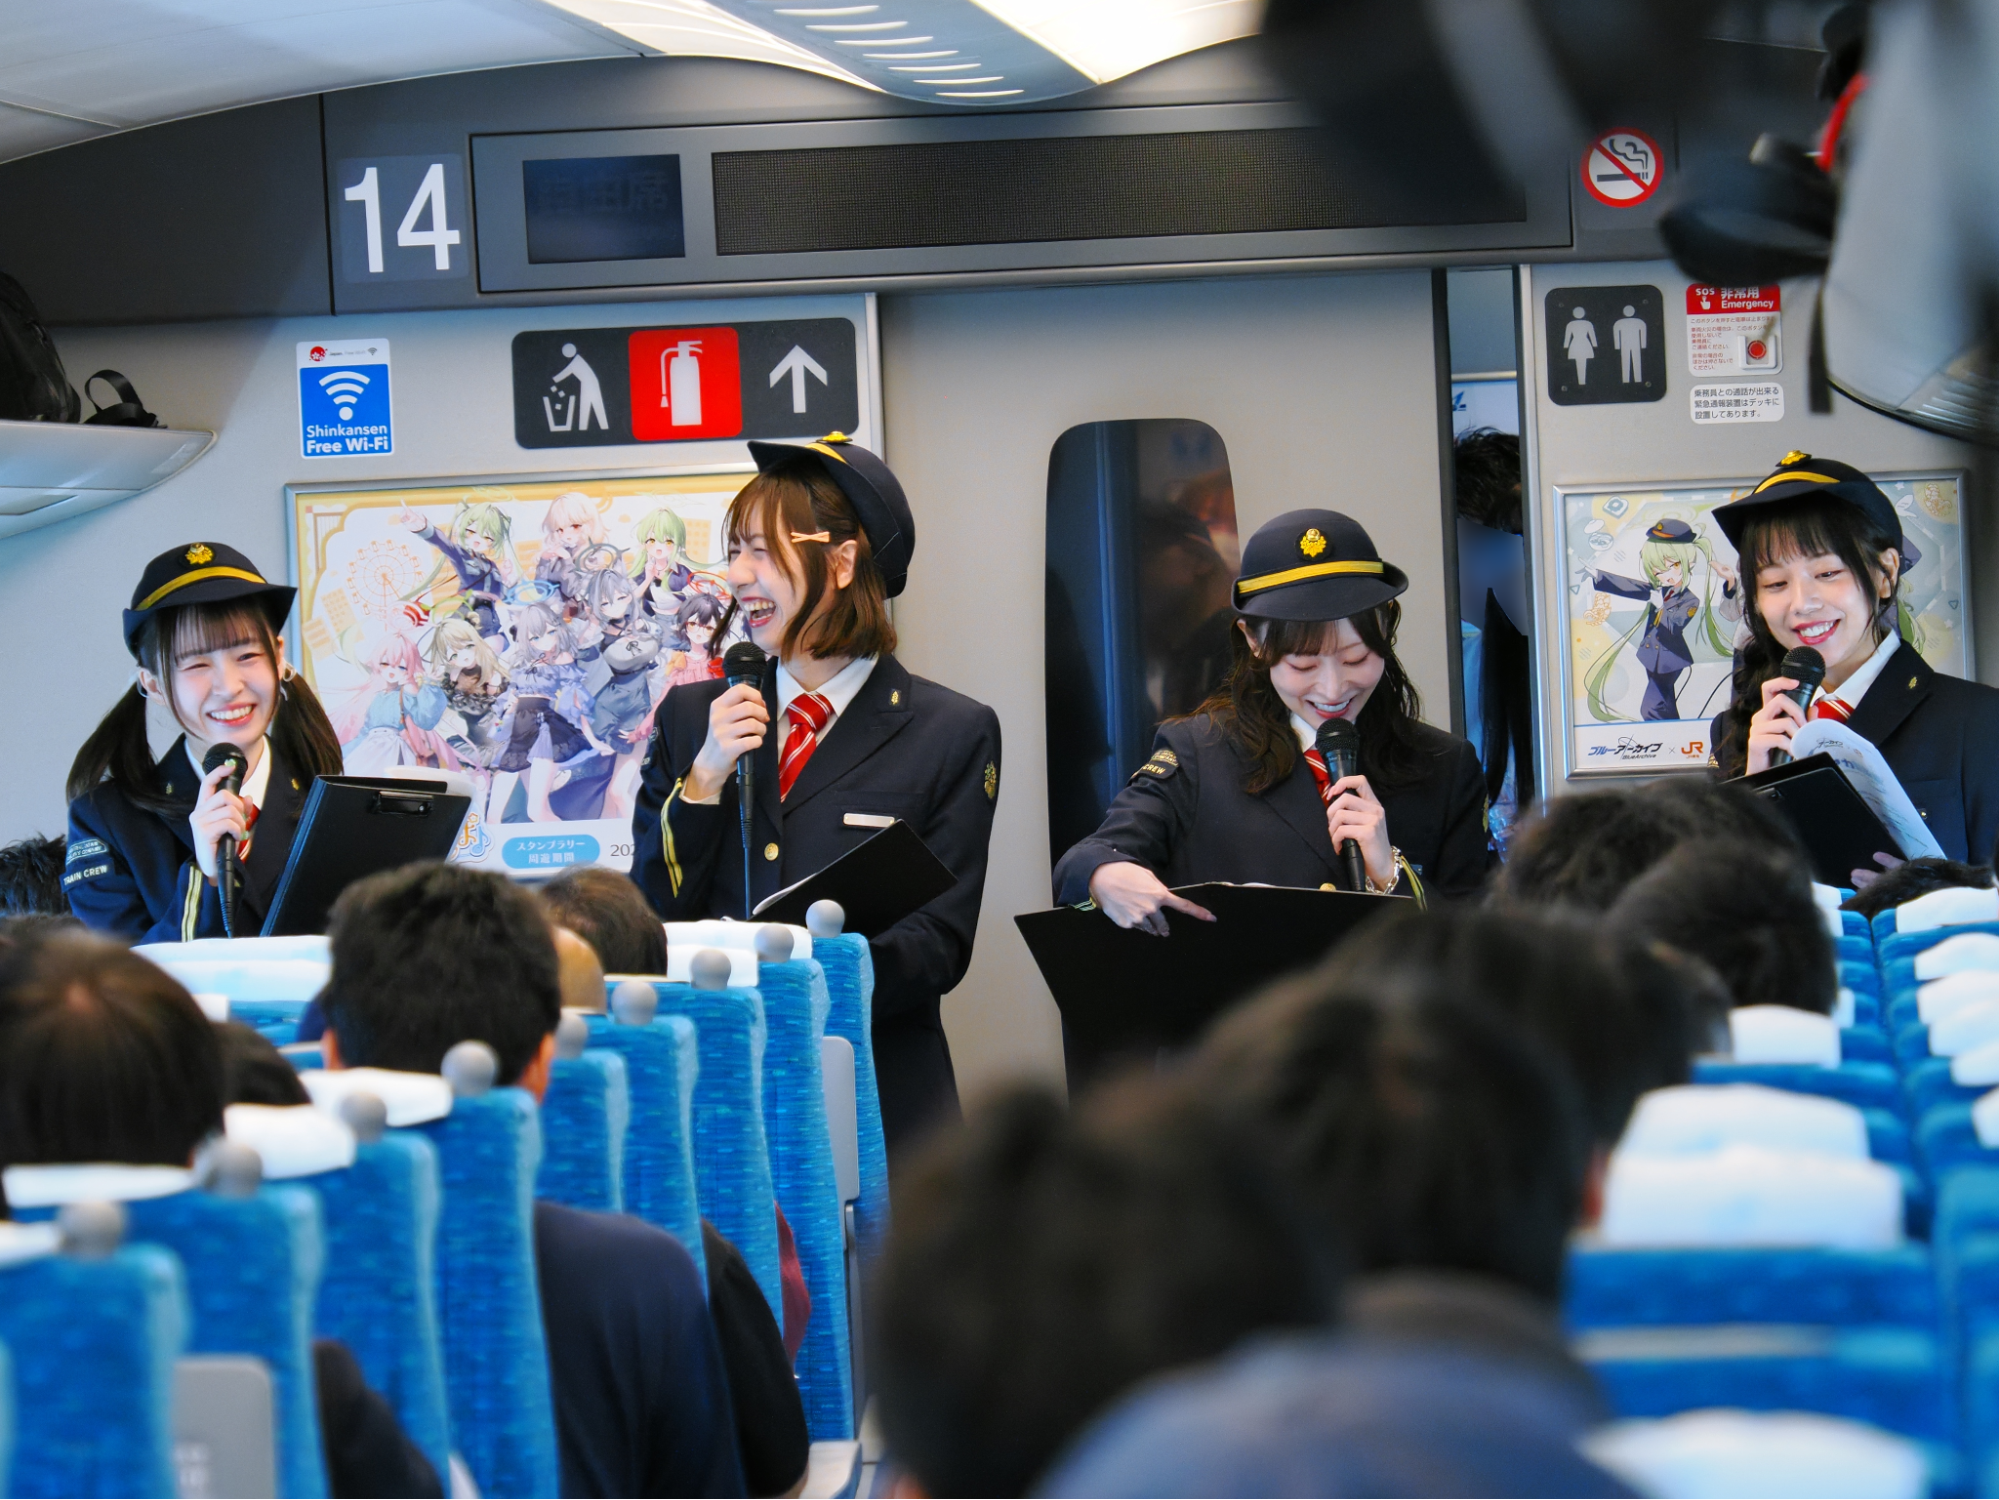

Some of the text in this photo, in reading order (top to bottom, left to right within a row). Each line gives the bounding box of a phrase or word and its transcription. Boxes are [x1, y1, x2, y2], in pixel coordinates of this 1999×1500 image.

[344, 163, 460, 273] 14
[1695, 287, 1715, 296] SOS
[1721, 286, 1760, 299] 非常用
[1721, 300, 1774, 309] Emergency
[1694, 387, 1779, 397] 乗務員との通話が出来る
[1694, 398, 1780, 408] 緊急通報装置はデッキに
[1695, 409, 1761, 419] 設置してあります。
[306, 423, 388, 438] Shinkansen
[306, 436, 389, 454] Free Wi-Fi
[1588, 742, 1663, 756] ブルーアーカイブ
[1681, 741, 1704, 755] JR
[1142, 763, 1166, 775] CREW
[517, 840, 586, 851] スタンプラリー
[528, 852, 575, 864] 周遊期間
[83, 864, 108, 878] CREW
